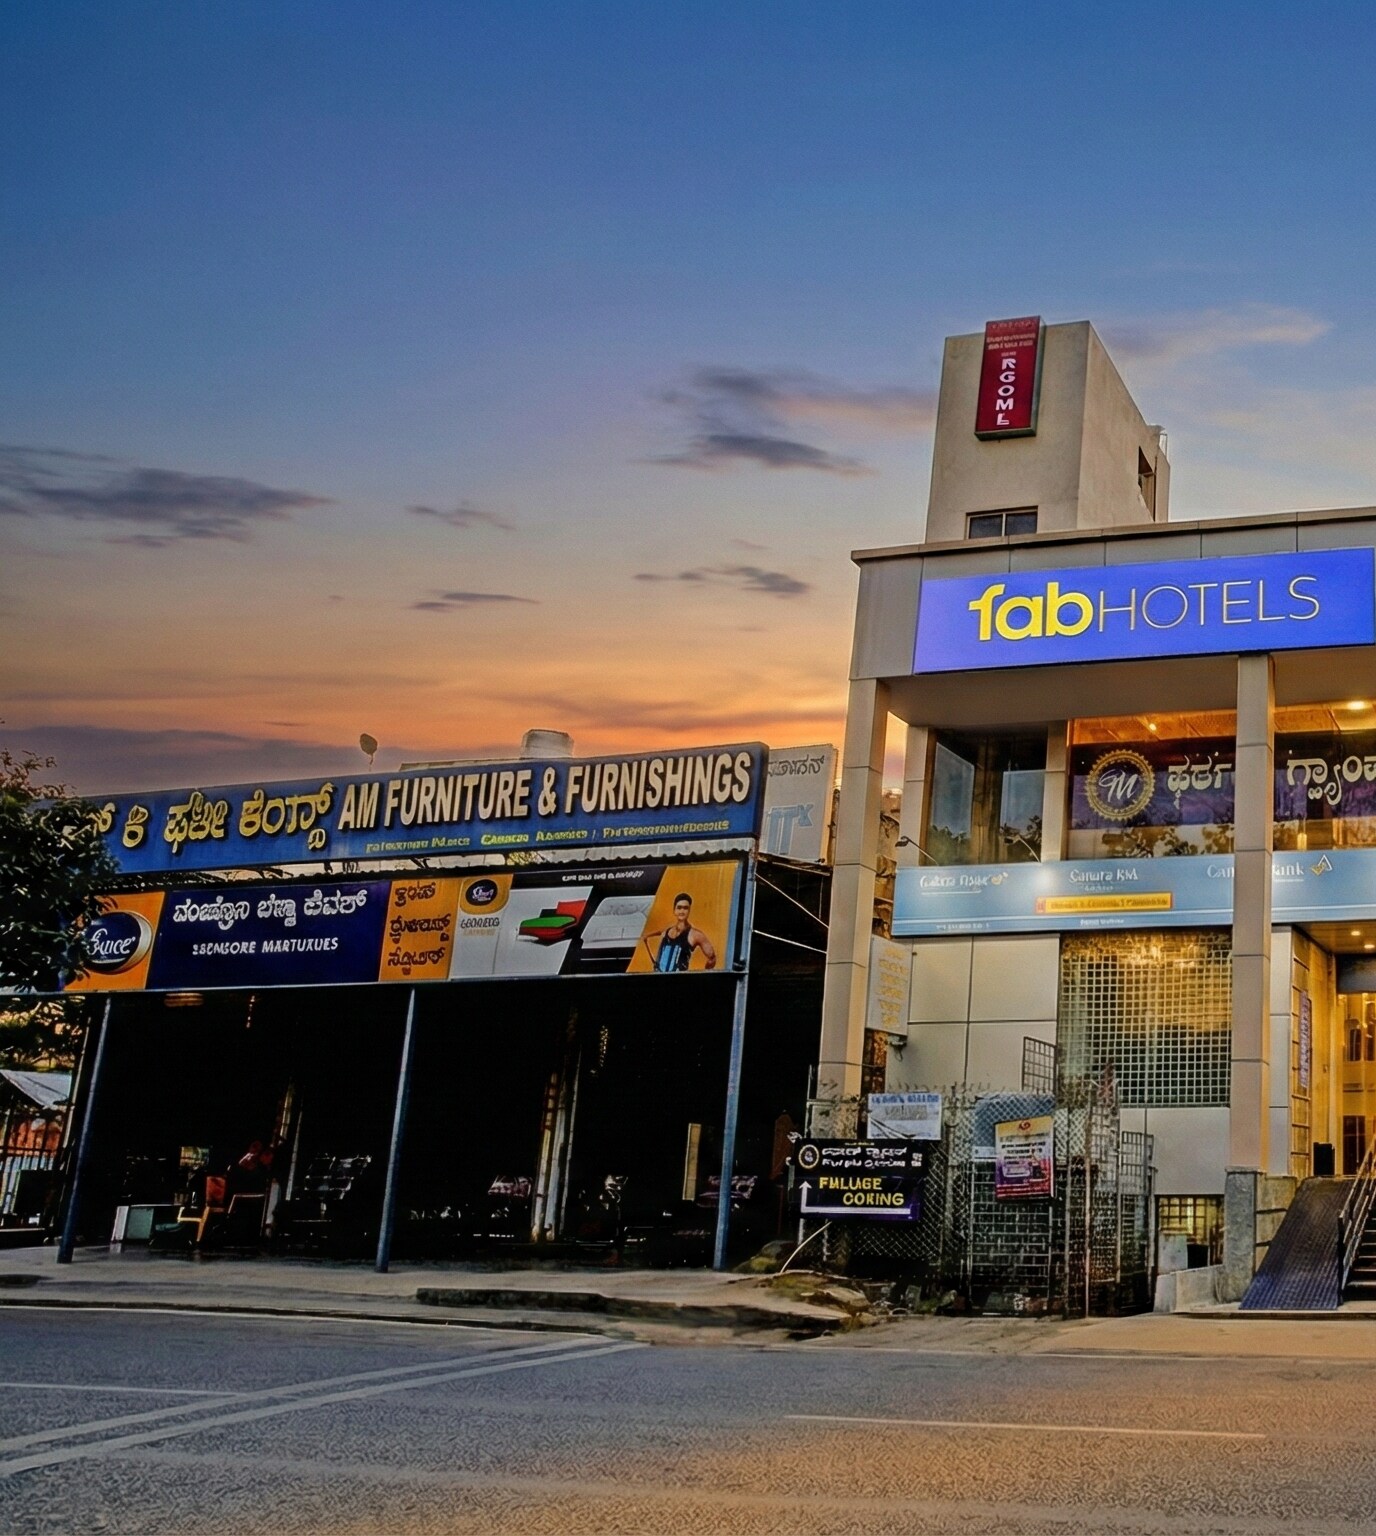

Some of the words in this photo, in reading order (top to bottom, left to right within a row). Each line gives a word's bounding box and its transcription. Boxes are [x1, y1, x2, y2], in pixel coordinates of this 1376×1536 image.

[338, 782, 380, 830] AM
[384, 769, 533, 827] FURNITURE
[538, 766, 557, 816] &
[565, 752, 751, 813] FURNISHINGS
